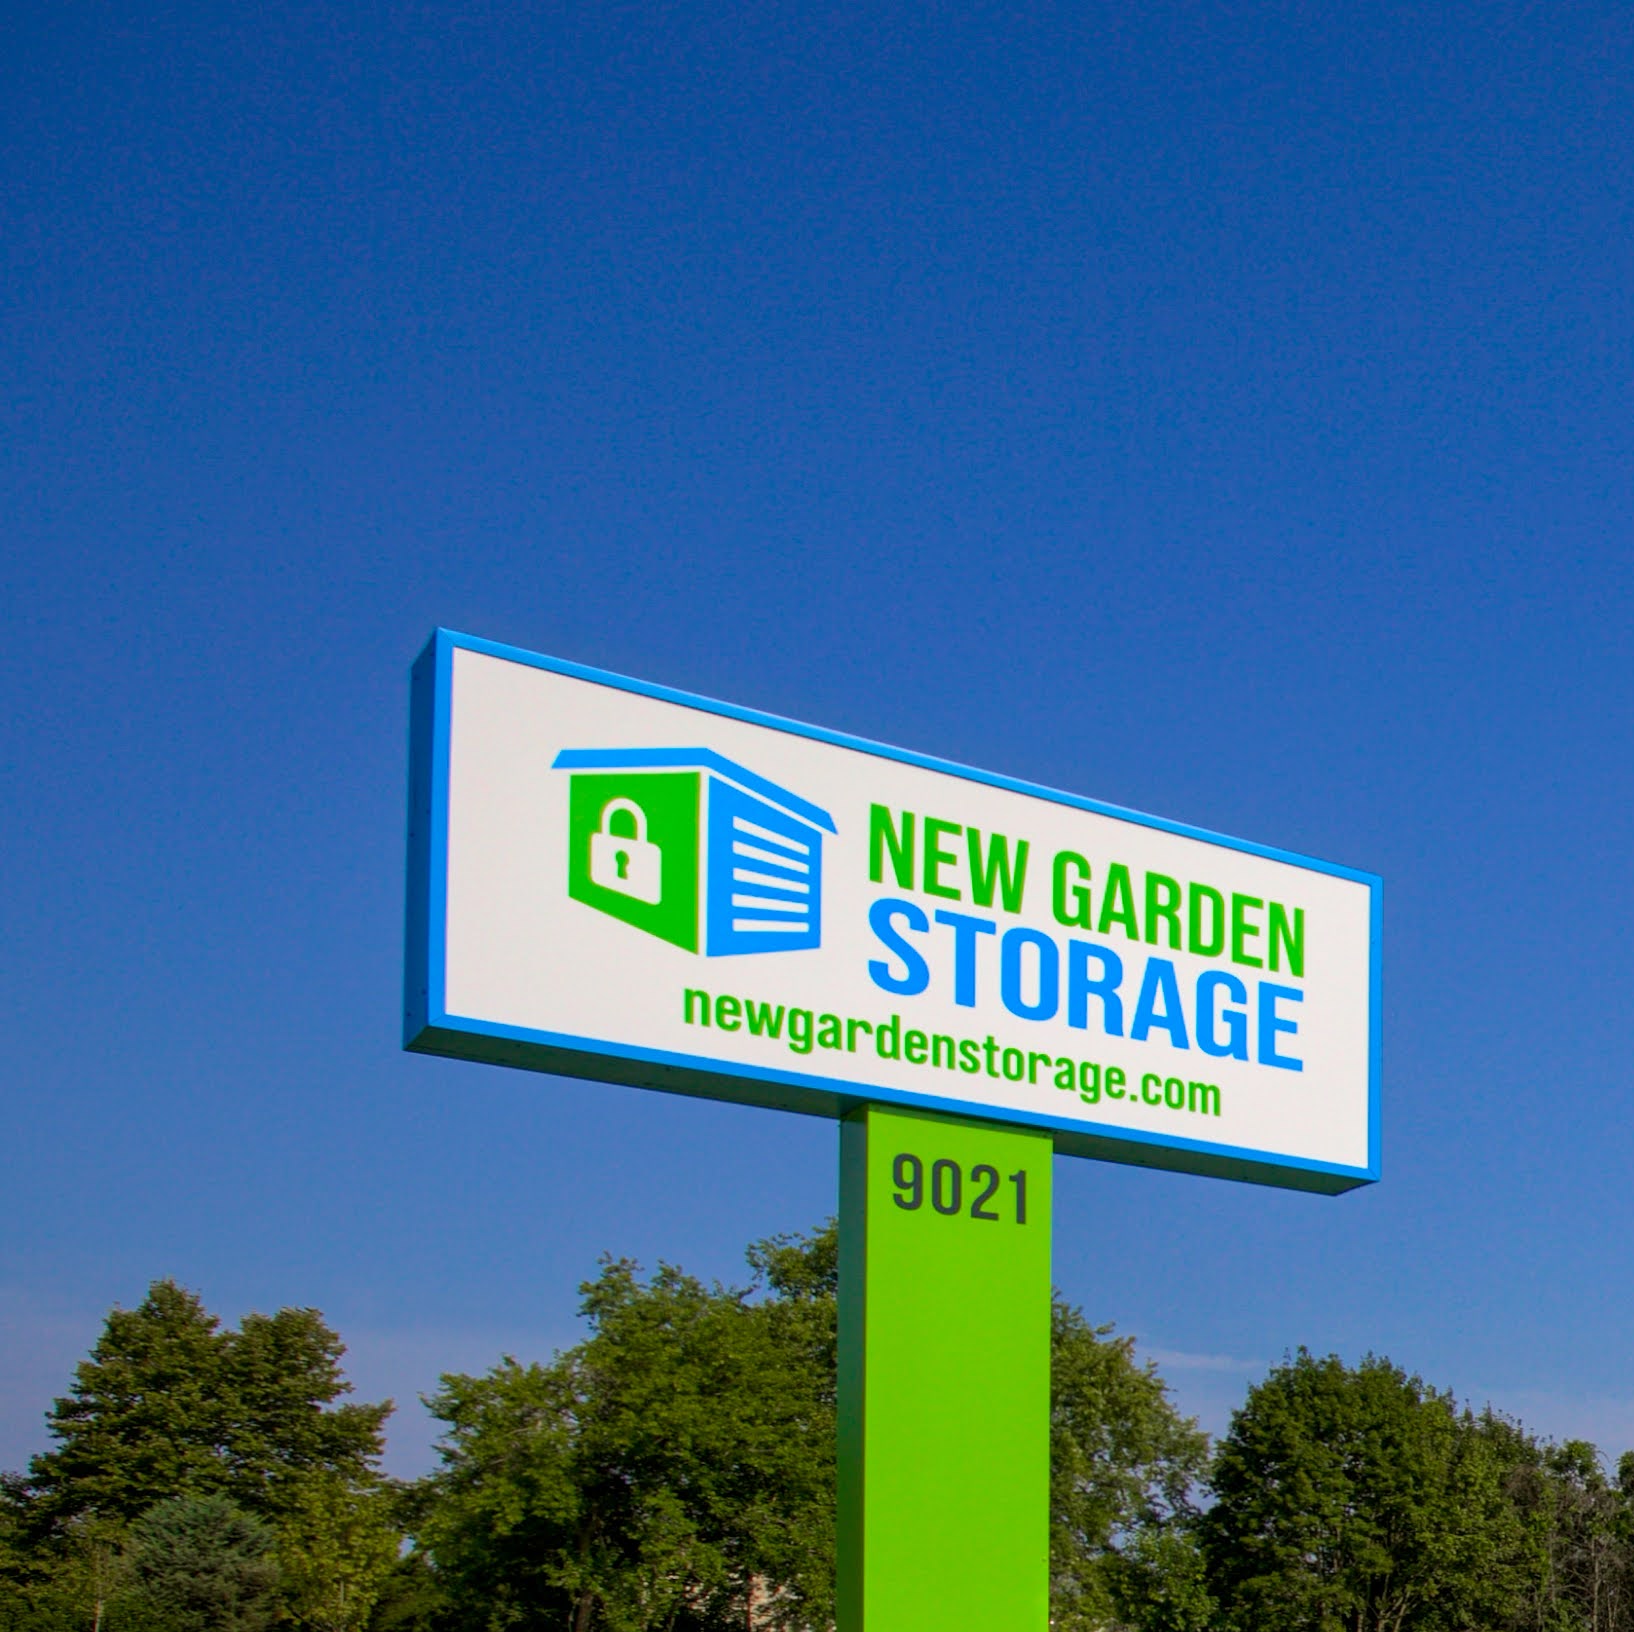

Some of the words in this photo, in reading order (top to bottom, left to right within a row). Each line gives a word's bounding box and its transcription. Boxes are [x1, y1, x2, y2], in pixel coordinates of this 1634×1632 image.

[867, 801, 1029, 914] NEW
[1051, 849, 1305, 978] GARDEN
[682, 987, 1222, 1118] newgardenstorage.com
[867, 897, 1305, 1073] STORAGE
[891, 1152, 1029, 1226] 9021
